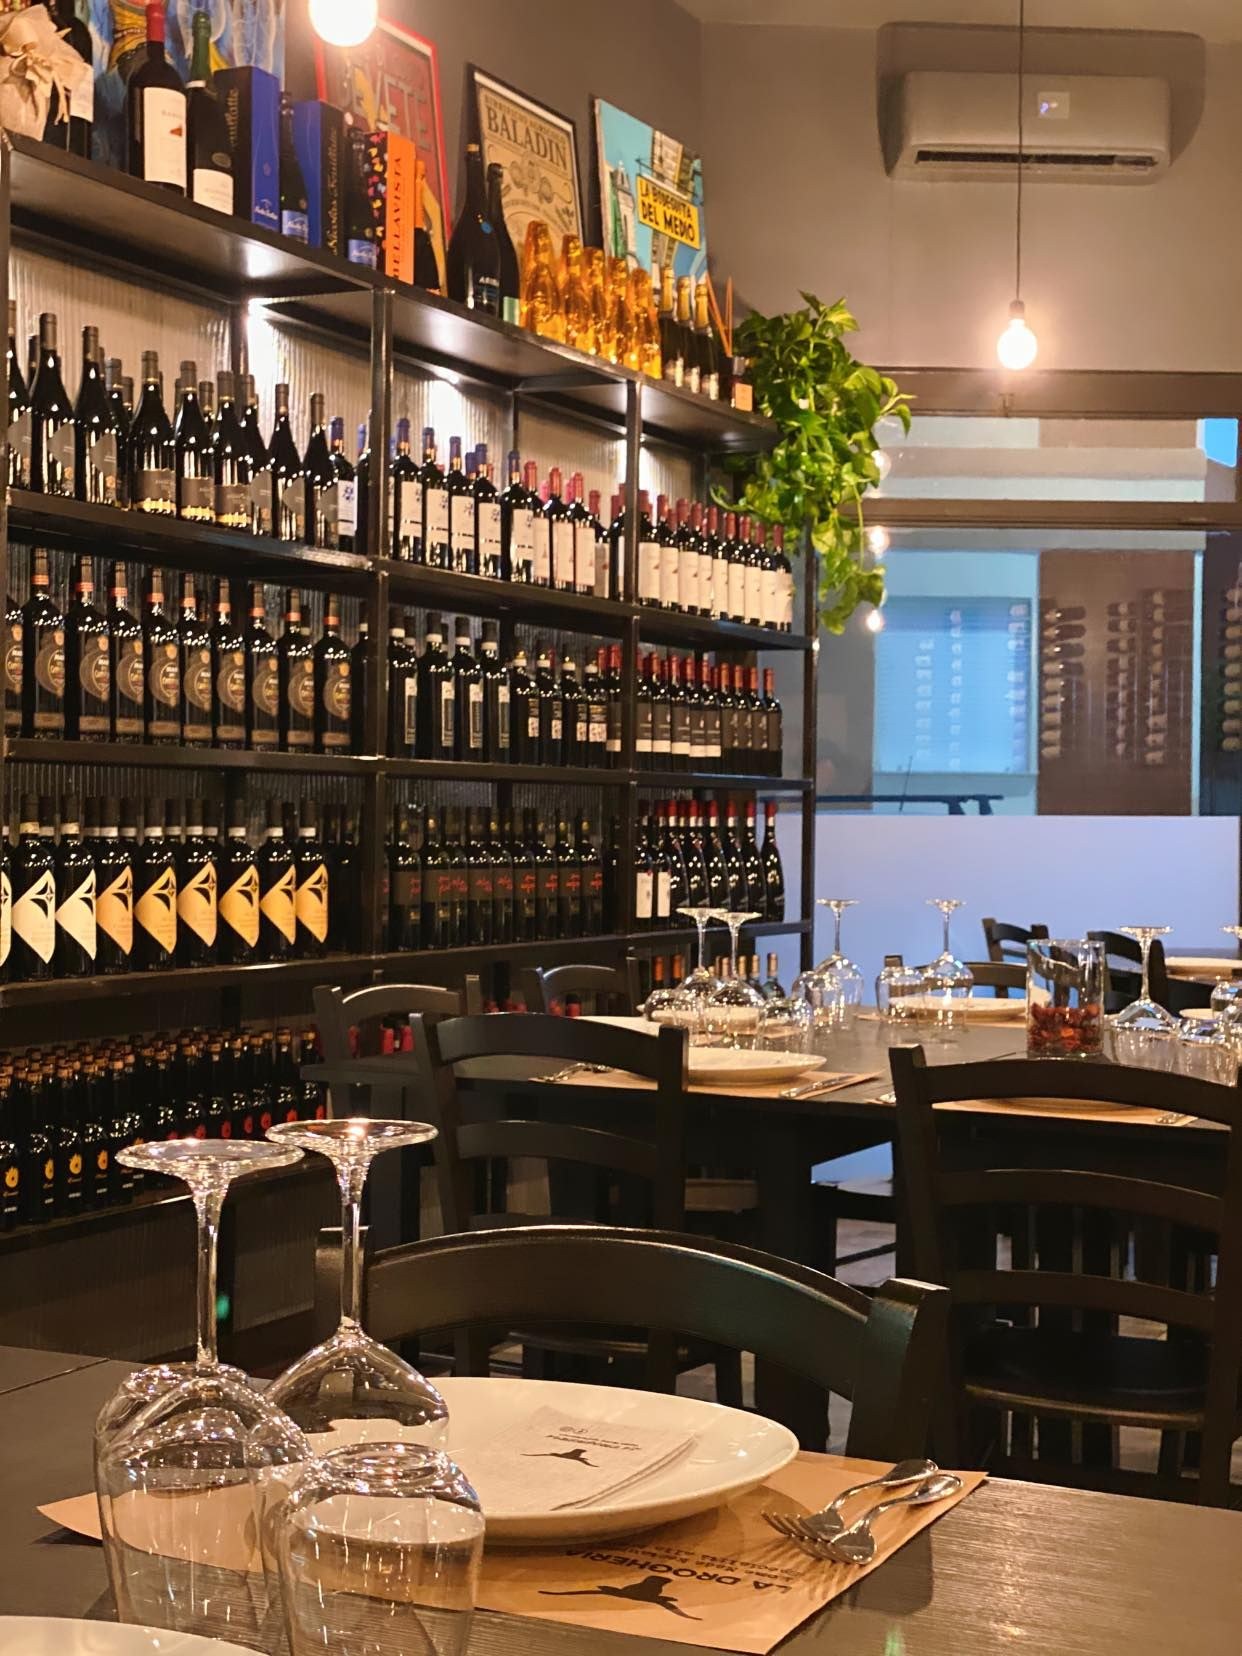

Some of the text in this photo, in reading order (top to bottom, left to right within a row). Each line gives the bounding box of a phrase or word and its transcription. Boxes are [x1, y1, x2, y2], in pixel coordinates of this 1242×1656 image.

[486, 105, 568, 171] BALADIN
[641, 200, 695, 242] DEL MEDIO
[566, 1550, 793, 1594] LA DROGHERIA
